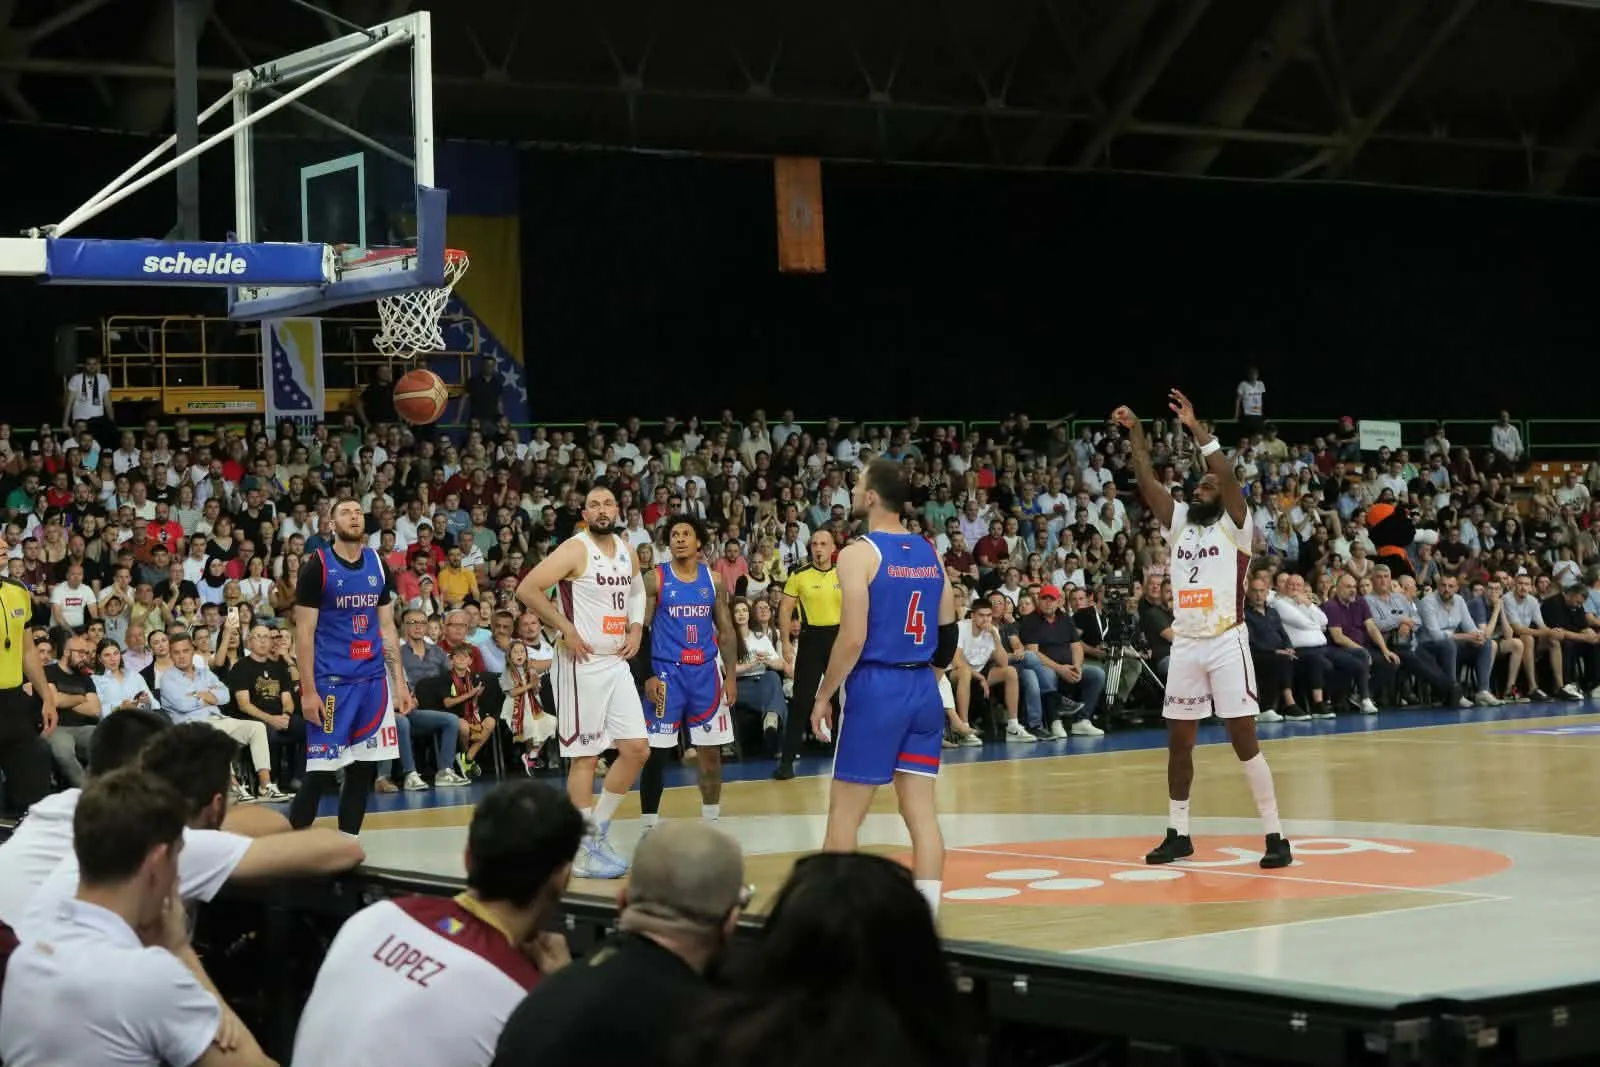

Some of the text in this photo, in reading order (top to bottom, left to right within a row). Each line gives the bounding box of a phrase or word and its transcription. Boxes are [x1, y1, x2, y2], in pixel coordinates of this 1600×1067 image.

[142, 251, 247, 274] schelde
[1188, 566, 1199, 584] 2
[611, 591, 625, 610] 16
[904, 590, 927, 645] 4
[718, 713, 728, 733] 11
[380, 726, 398, 747] 19
[373, 934, 447, 987] LOPEZ
